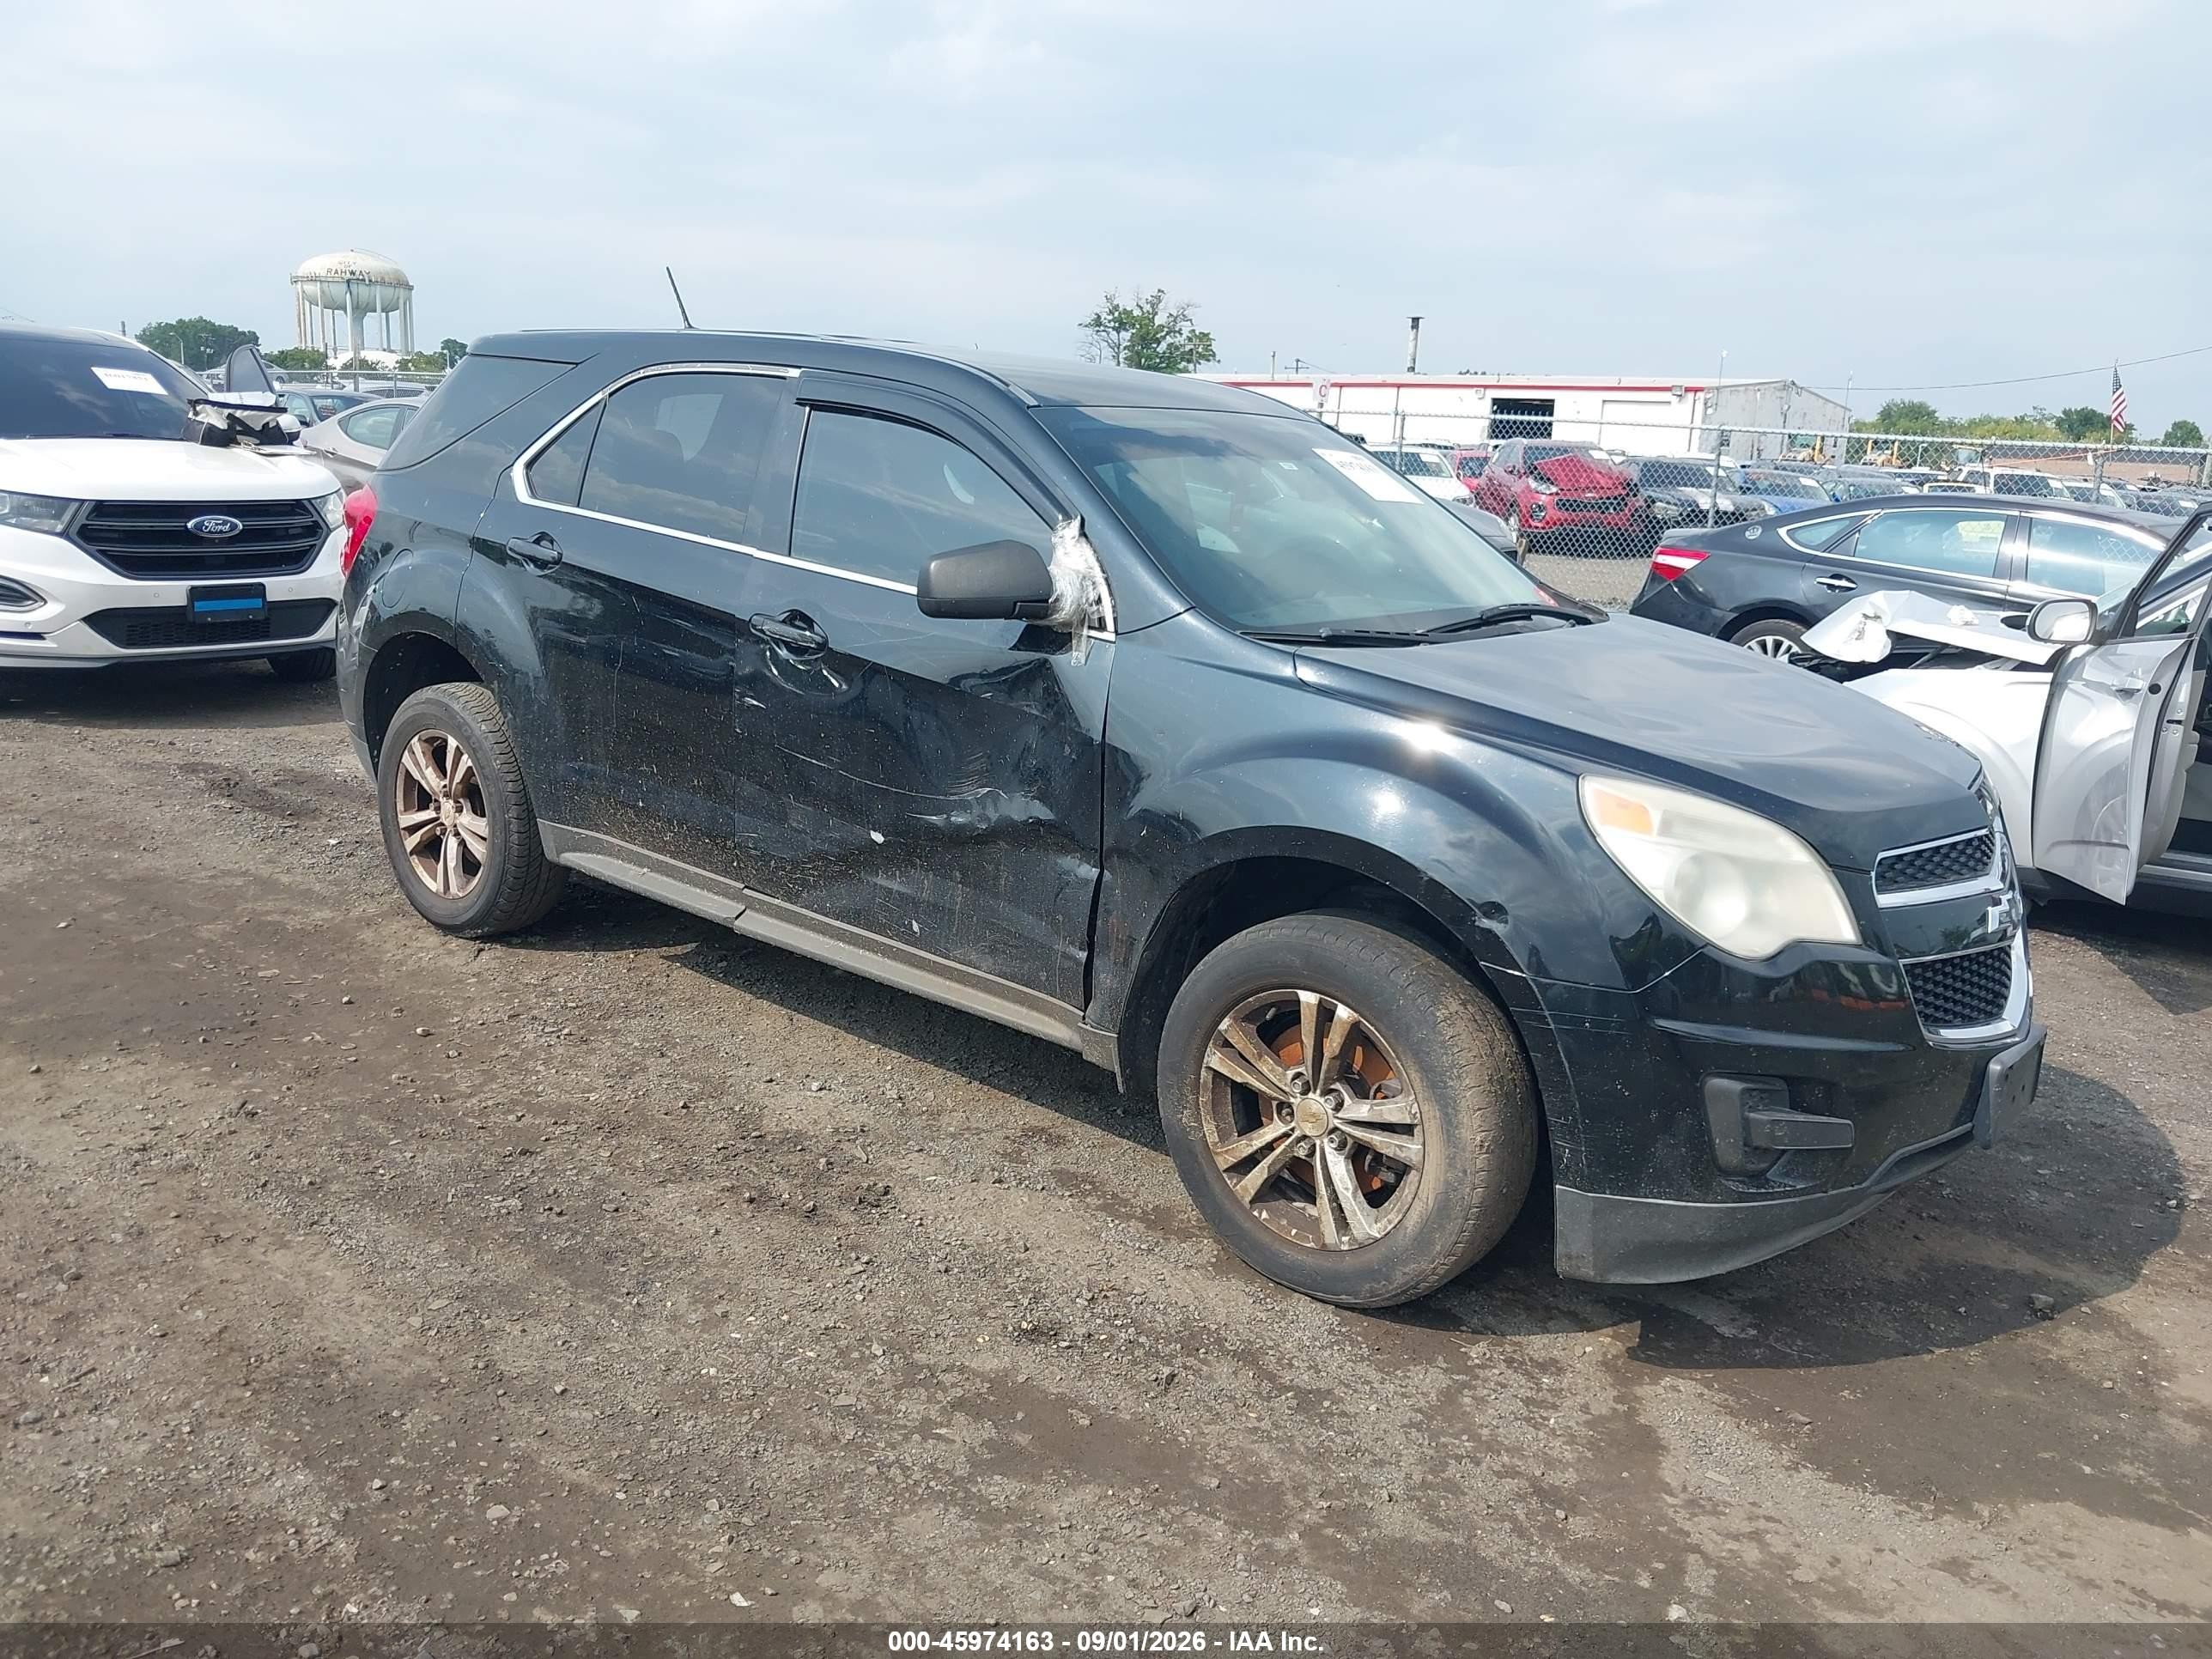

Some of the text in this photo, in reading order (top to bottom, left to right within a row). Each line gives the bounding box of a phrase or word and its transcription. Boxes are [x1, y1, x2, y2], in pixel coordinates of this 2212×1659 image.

[326, 267, 371, 277] RAHWAY
[1319, 384, 1328, 398] C
[202, 520, 231, 532] Ford
